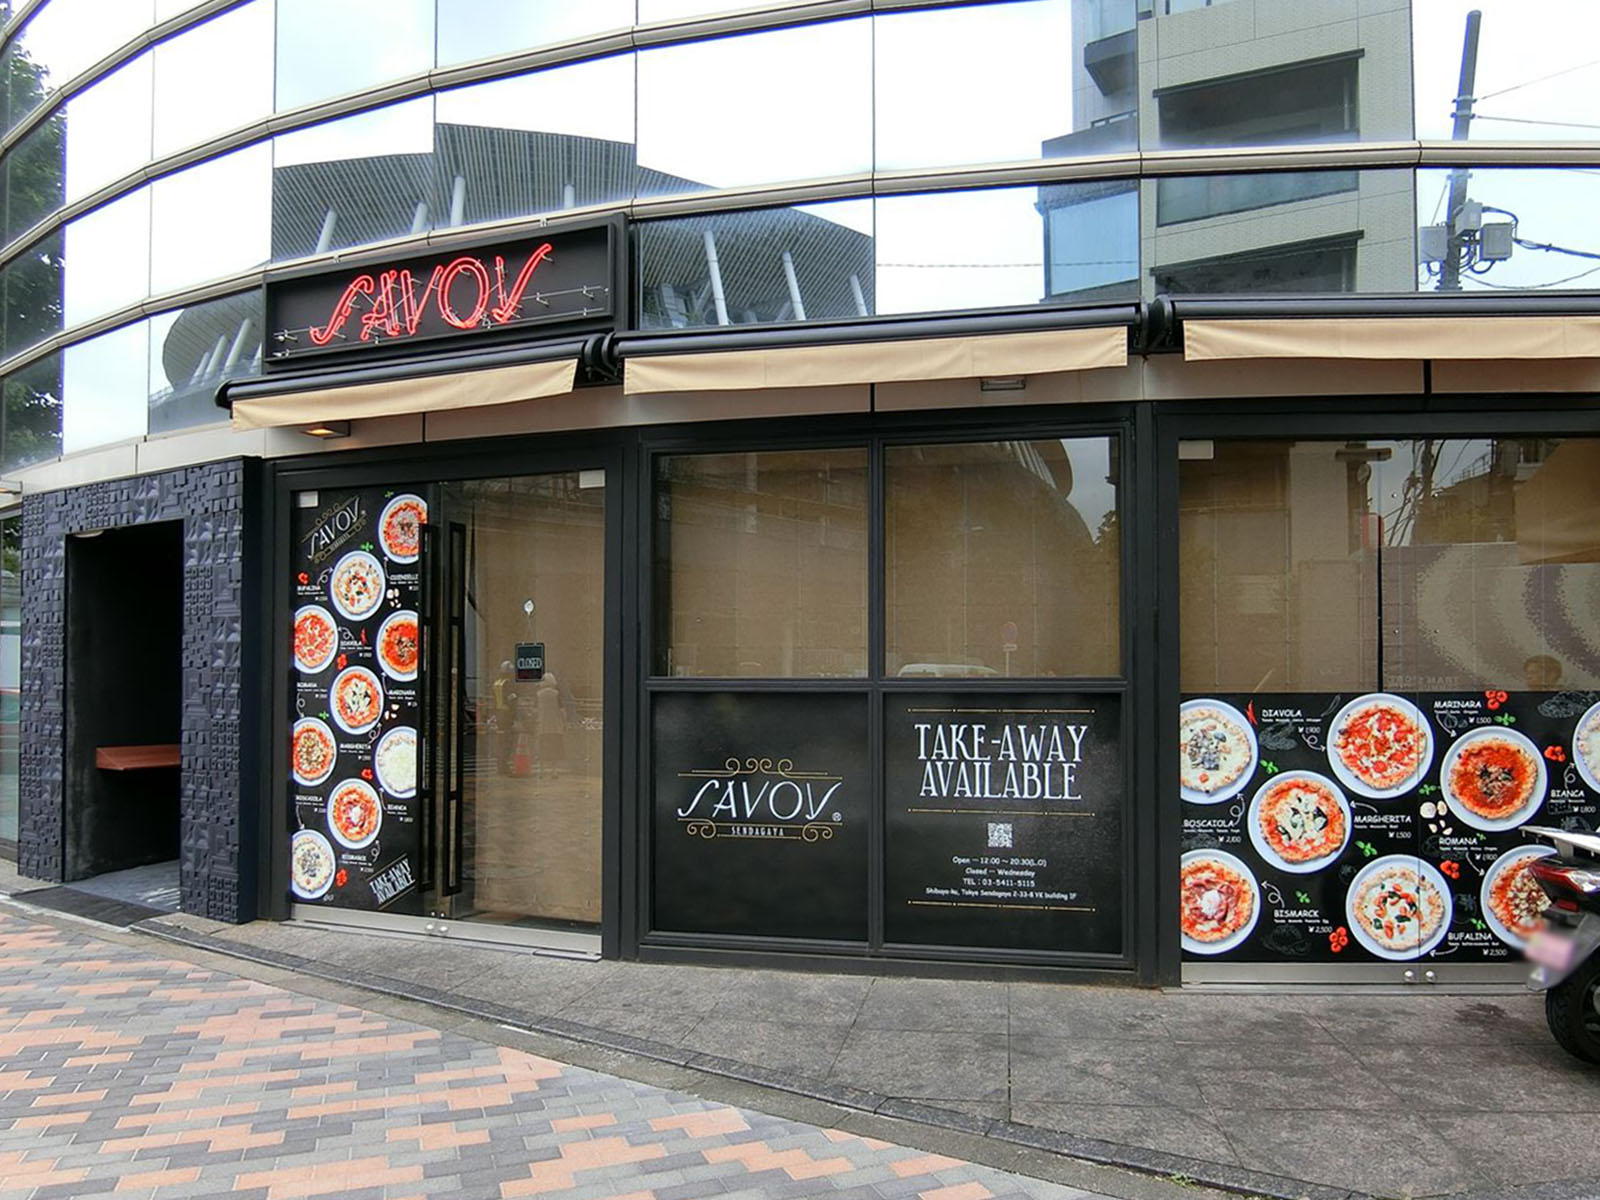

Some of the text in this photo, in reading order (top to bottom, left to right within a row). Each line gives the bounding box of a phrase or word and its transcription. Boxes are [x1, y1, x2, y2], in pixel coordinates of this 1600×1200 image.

[1434, 700, 1482, 709] MARINARA
[1262, 709, 1303, 718] DIAVOLA
[914, 724, 1088, 762] TAKE-AWAY
[919, 761, 1082, 800] AVAILABLE
[1550, 789, 1585, 798] BIANCA
[1183, 819, 1235, 828] BOSCAIOLA
[1354, 815, 1412, 824] MARGHERITA
[731, 826, 784, 836] SENDAGAYA
[1439, 837, 1478, 846] ROMANA
[952, 856, 971, 865] Open
[1273, 909, 1320, 918] BISMARCK
[1448, 932, 1493, 941] BUFALINA
